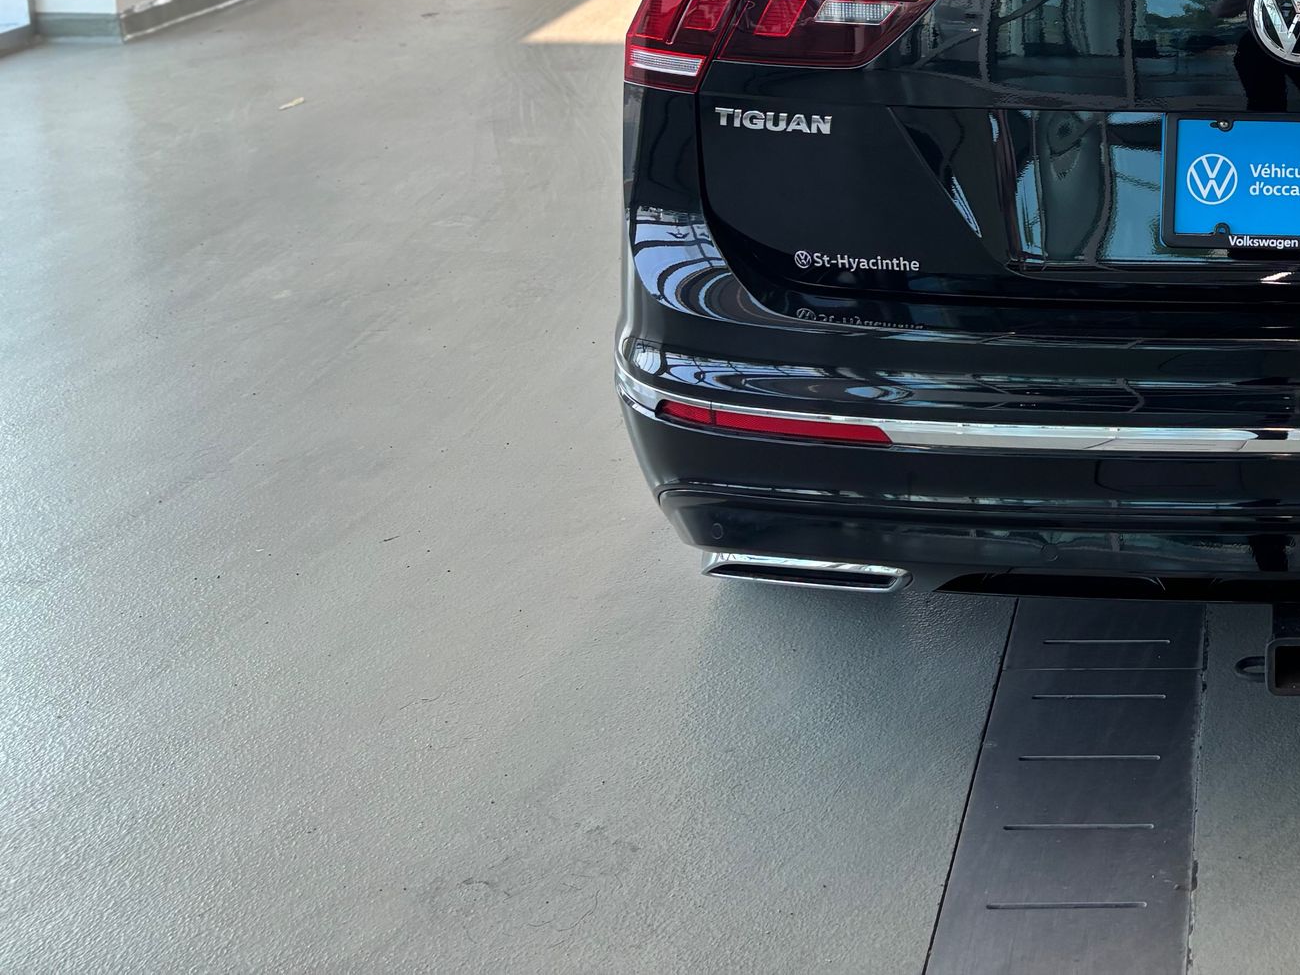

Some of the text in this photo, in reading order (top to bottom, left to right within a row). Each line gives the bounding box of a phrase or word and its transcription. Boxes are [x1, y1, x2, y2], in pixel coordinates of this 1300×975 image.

[714, 106, 833, 135] TIGUAN
[1228, 235, 1299, 249] Volkswagen
[813, 253, 920, 272] St-Hyacinthe
